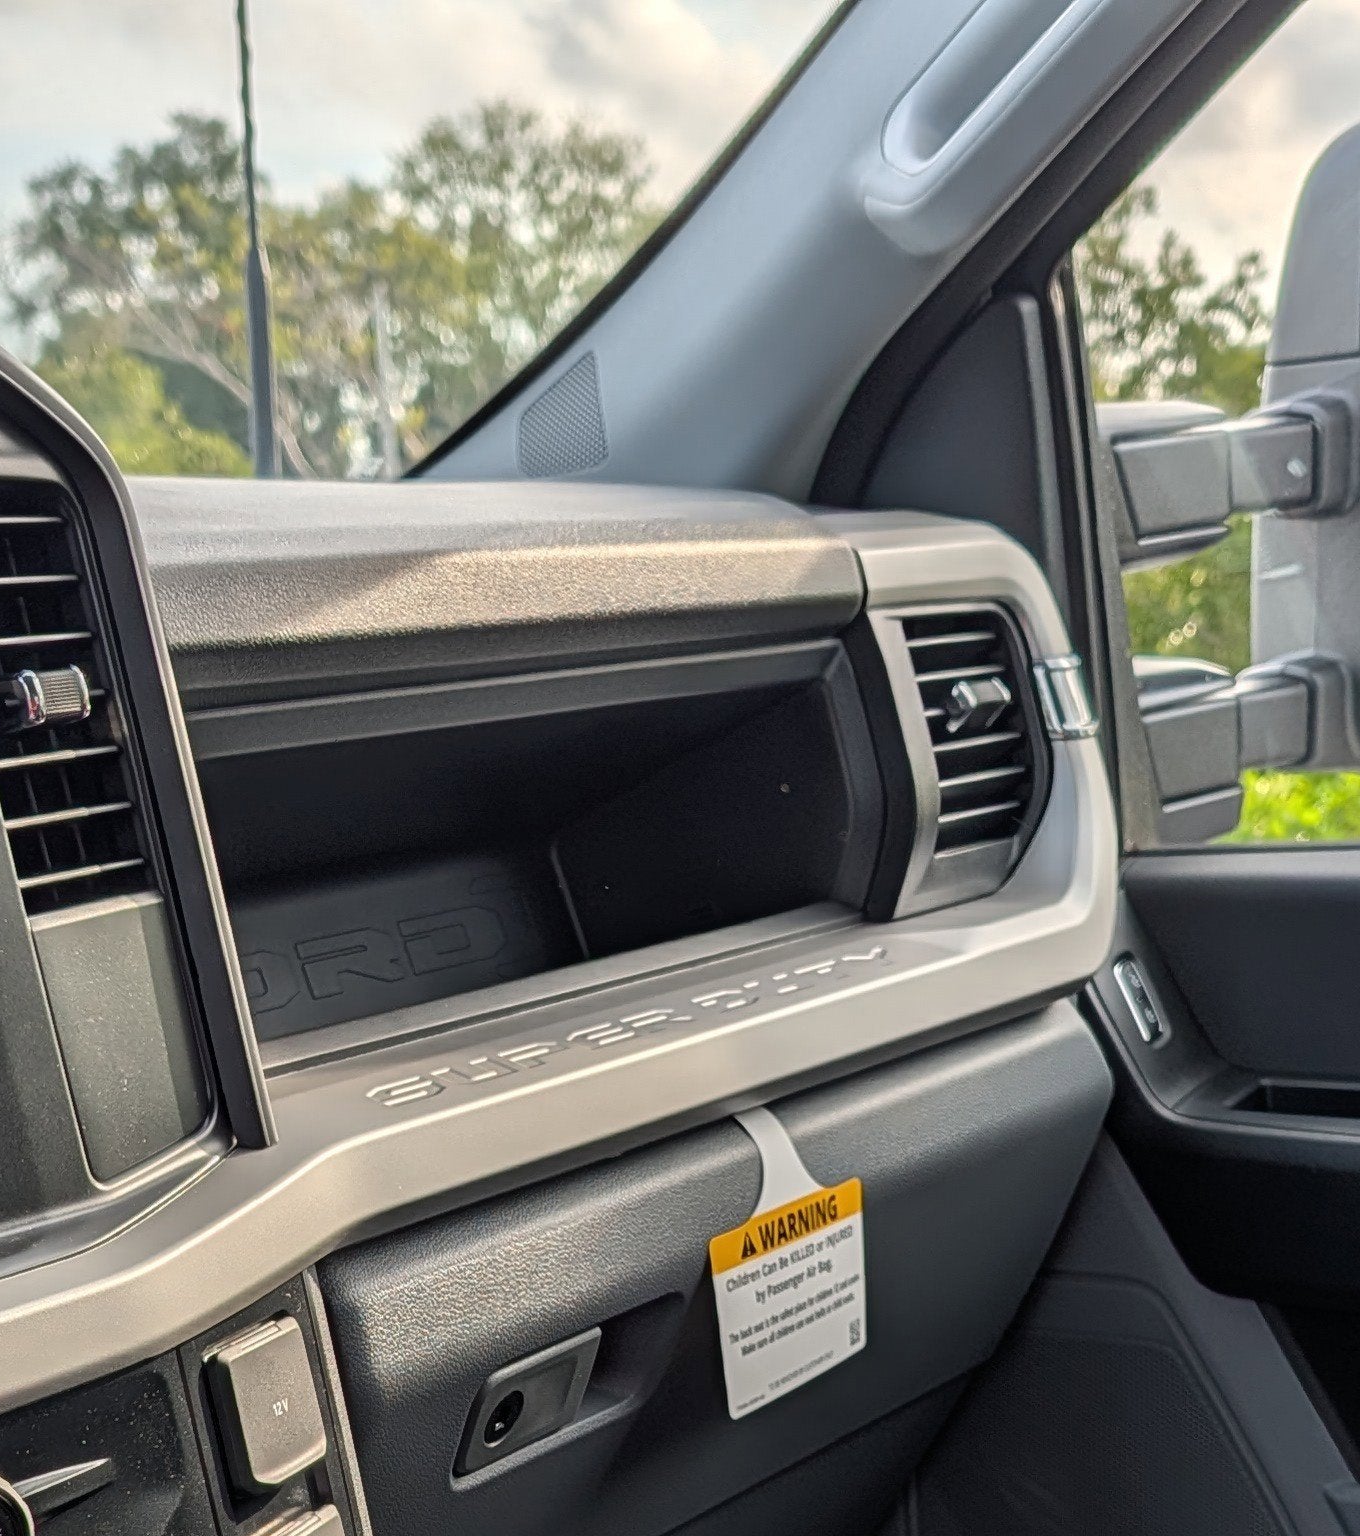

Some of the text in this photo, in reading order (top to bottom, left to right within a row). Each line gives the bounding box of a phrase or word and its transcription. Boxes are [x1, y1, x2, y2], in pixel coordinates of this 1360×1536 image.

[365, 1007, 693, 1108] SUPER
[757, 1194, 838, 1252] WARNING
[726, 1269, 761, 1293] Children
[761, 1262, 778, 1278] Can
[778, 1256, 789, 1270] Be
[789, 1243, 815, 1265] KILLED
[755, 1289, 766, 1305] by
[766, 1271, 805, 1298] Passenger
[806, 1265, 817, 1280] Air
